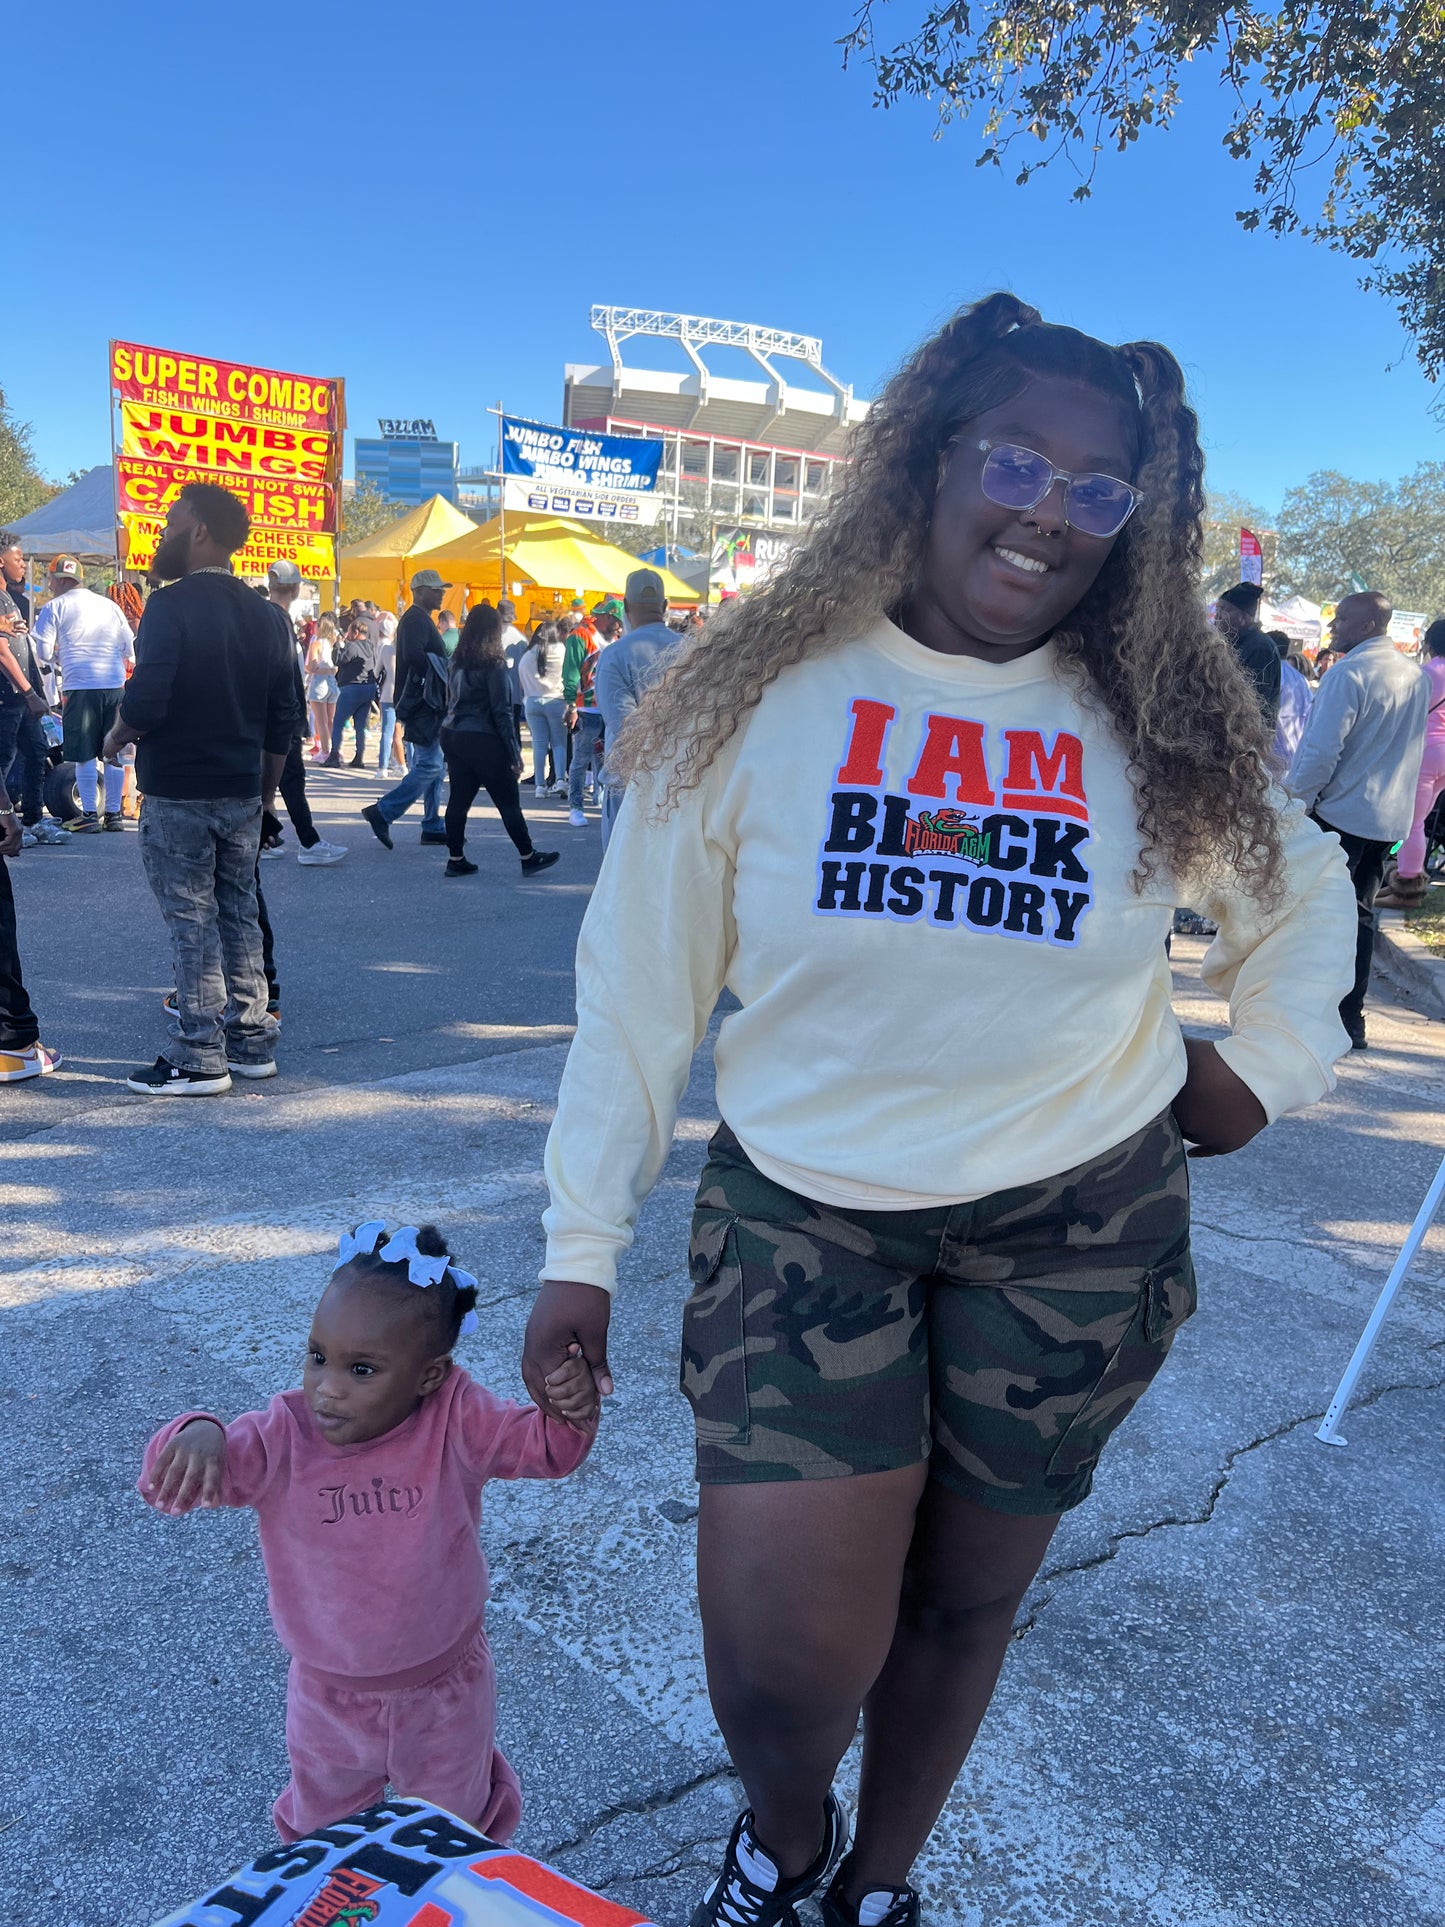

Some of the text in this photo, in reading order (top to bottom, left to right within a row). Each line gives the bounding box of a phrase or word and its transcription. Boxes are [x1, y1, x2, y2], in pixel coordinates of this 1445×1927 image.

[113, 348, 331, 416] SUPER COMBO
[143, 388, 307, 428] FISH WINGS SHRIMP
[130, 412, 333, 457] JUMBO
[504, 425, 604, 456] JUMBO FISH
[118, 461, 168, 479] REAL
[172, 468, 247, 490] CATFISH
[253, 474, 288, 494] NOT
[137, 437, 328, 479] WINGS
[519, 445, 632, 473] JUMBO WINGS
[124, 477, 325, 521] CAISH
[535, 485, 637, 505] ALL VEGETARIAN SIDE ORDERS
[590, 472, 651, 490] SHRIMP
[250, 514, 310, 529] GULAR
[253, 531, 316, 547] CHEESE
[241, 560, 331, 577] FRI KRA
[837, 698, 1087, 807] I AM
[904, 818, 992, 865] FLORIDA A&M
[817, 861, 1090, 942] HISTORY
[318, 1477, 424, 1525] Juicy
